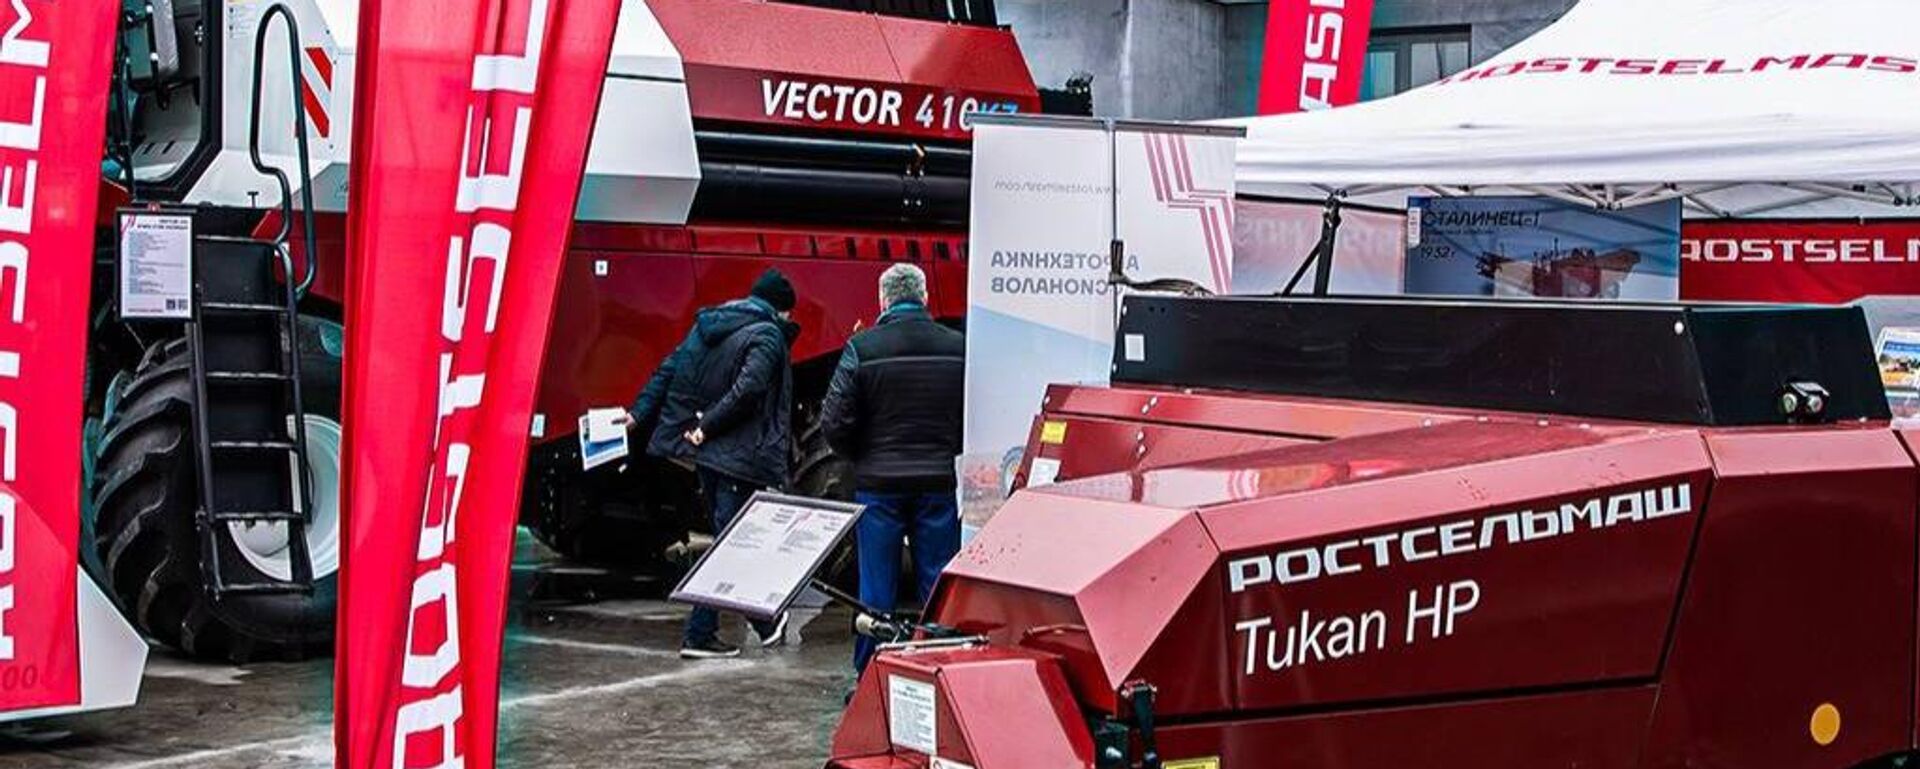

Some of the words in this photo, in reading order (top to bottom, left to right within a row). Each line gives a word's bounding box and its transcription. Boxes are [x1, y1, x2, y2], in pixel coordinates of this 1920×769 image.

[762, 79, 902, 126] VECTOR
[1228, 483, 1691, 592] РОСТСЕЛЬМАШ
[1235, 610, 1386, 675] Tukan
[1405, 579, 1480, 644] HP
